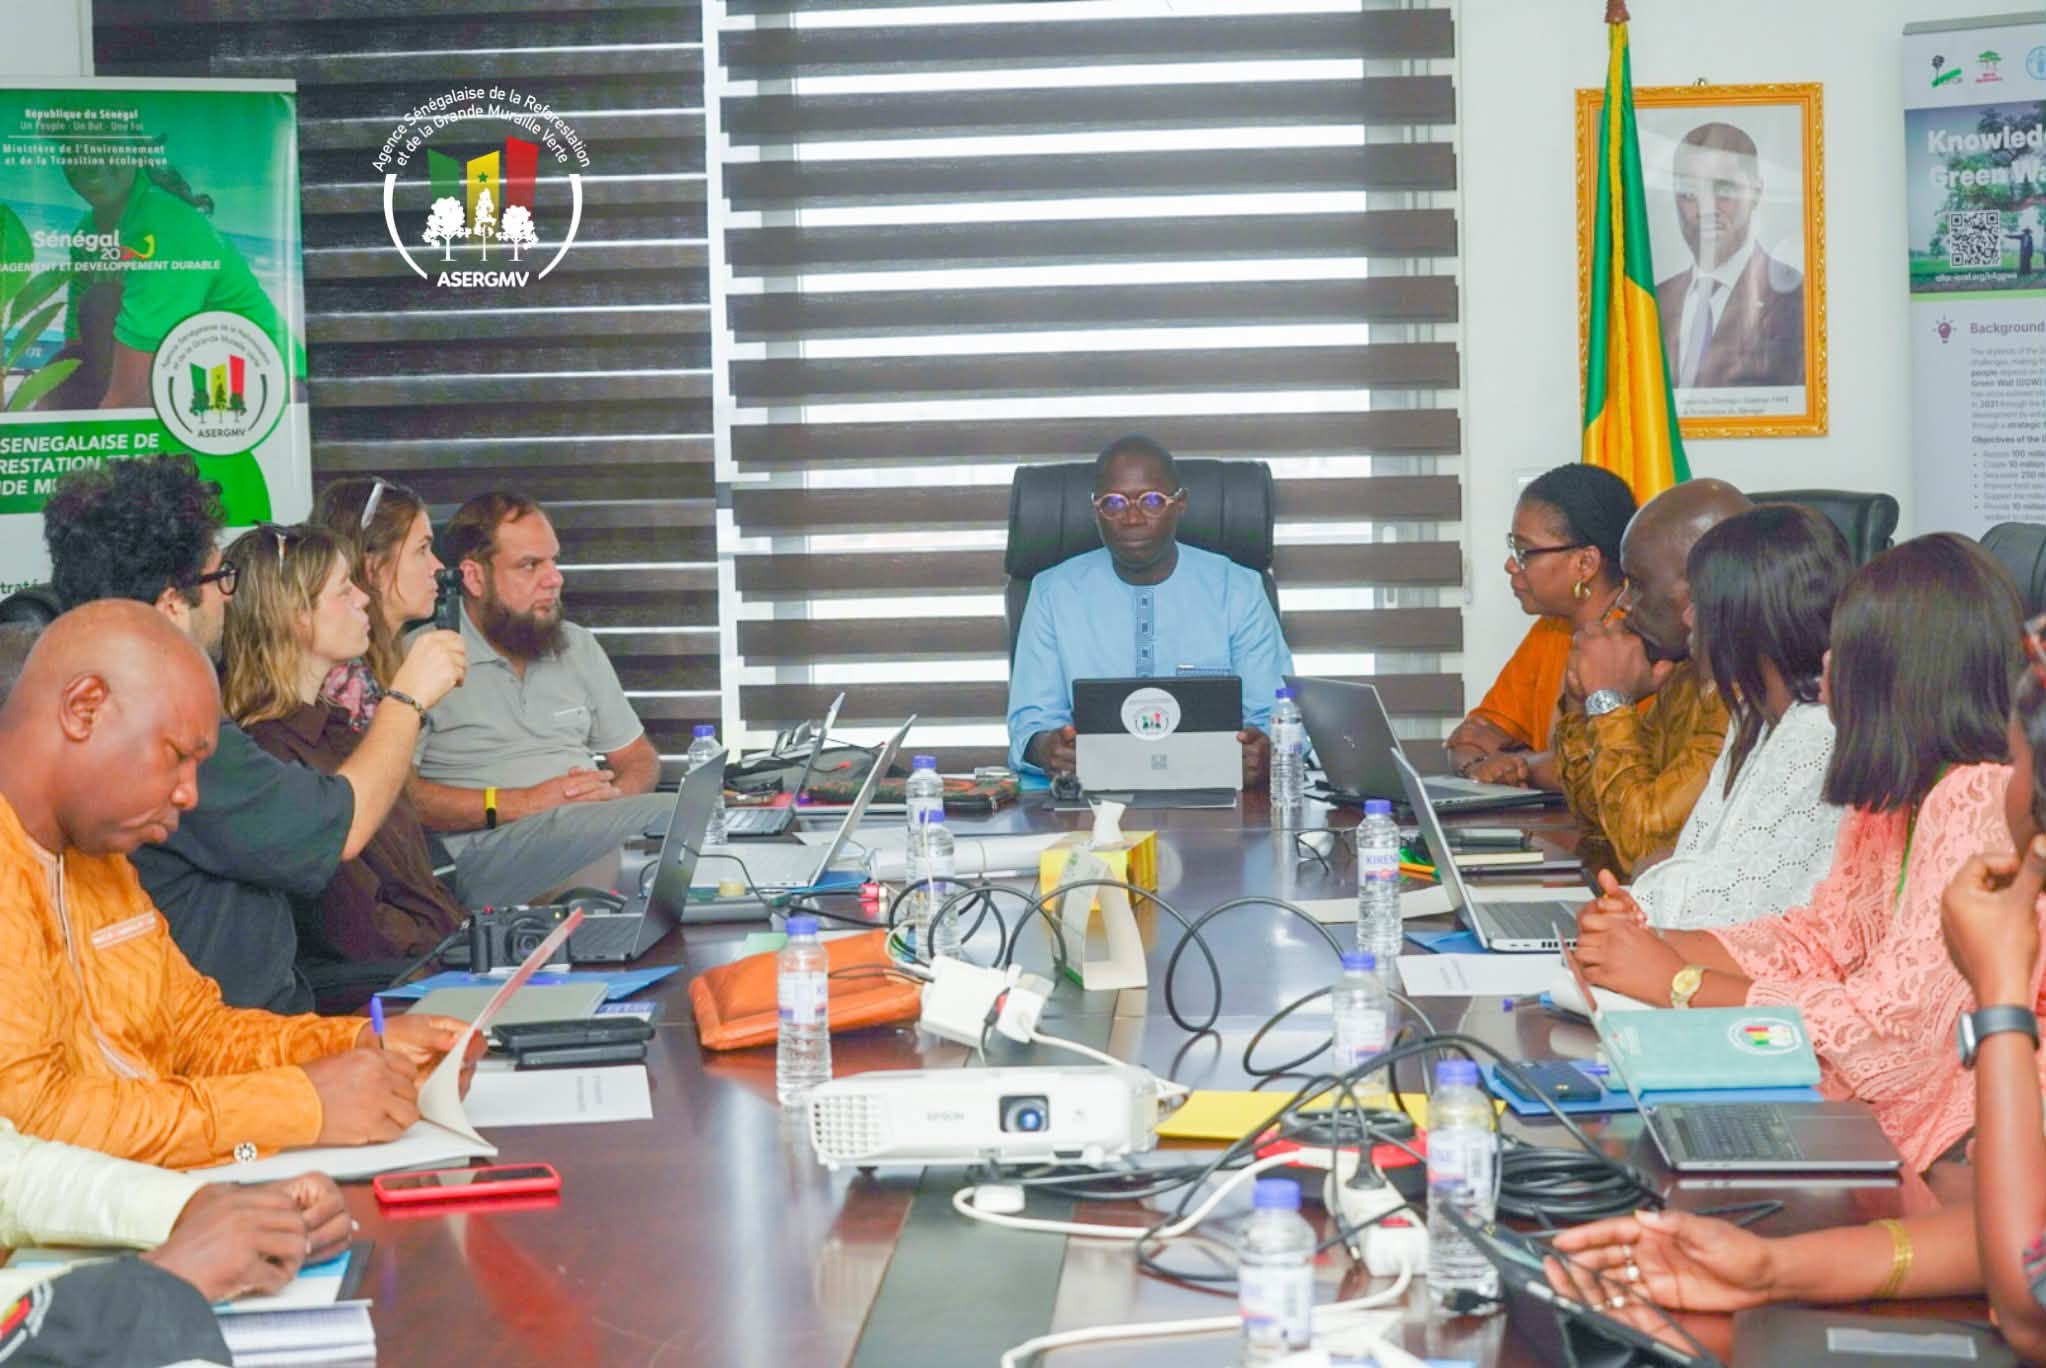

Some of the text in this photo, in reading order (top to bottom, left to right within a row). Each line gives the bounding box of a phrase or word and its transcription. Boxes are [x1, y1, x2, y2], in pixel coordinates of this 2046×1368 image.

[25, 109, 81, 120] République
[84, 109, 97, 119] du
[1928, 164, 2009, 189] Green
[33, 230, 120, 251] Sénégal
[1970, 320, 2045, 336] Background
[0, 432, 160, 453] SENEGALAISE DE
[0, 479, 28, 496] DE
